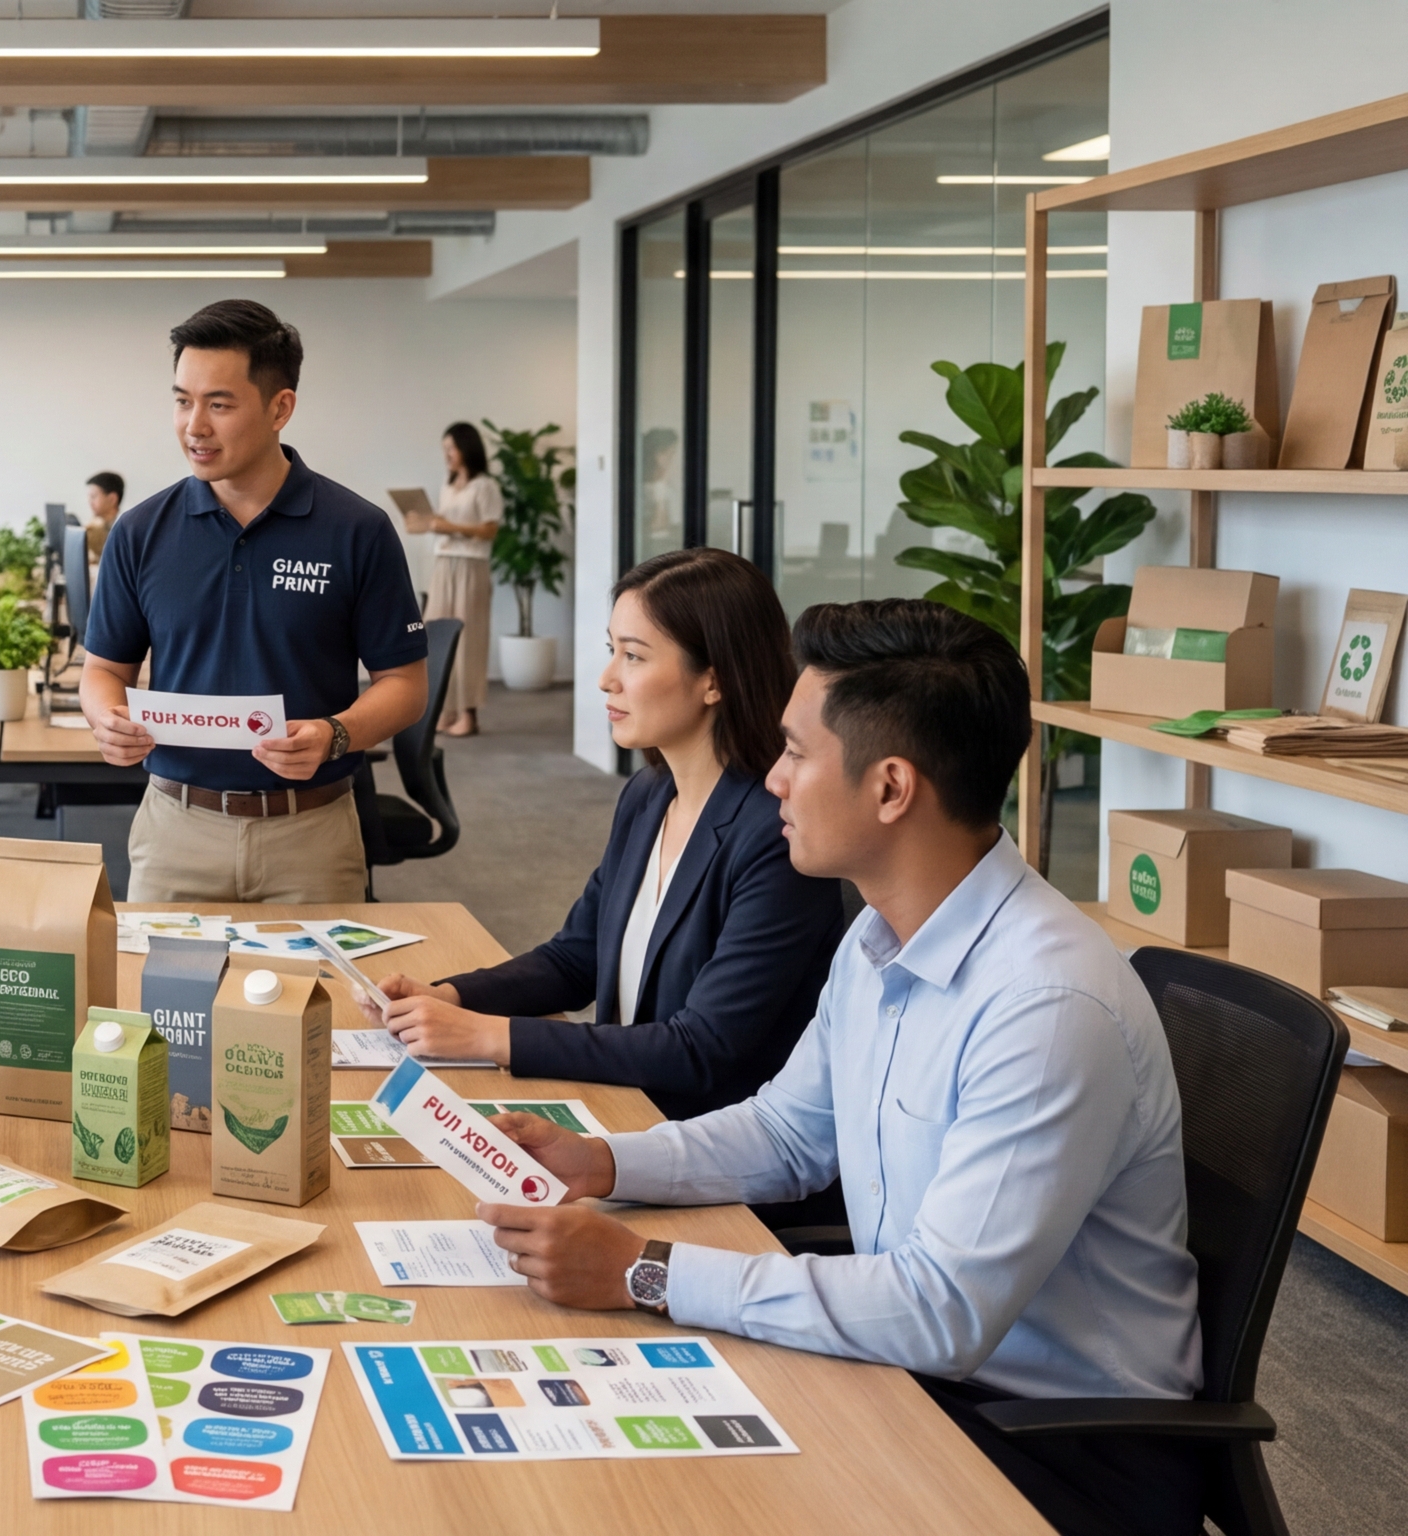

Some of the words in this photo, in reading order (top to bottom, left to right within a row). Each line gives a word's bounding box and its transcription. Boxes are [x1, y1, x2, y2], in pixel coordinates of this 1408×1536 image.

[272, 558, 332, 577] GIANT
[272, 574, 331, 595] PRINT
[153, 1008, 206, 1028] GIANT
